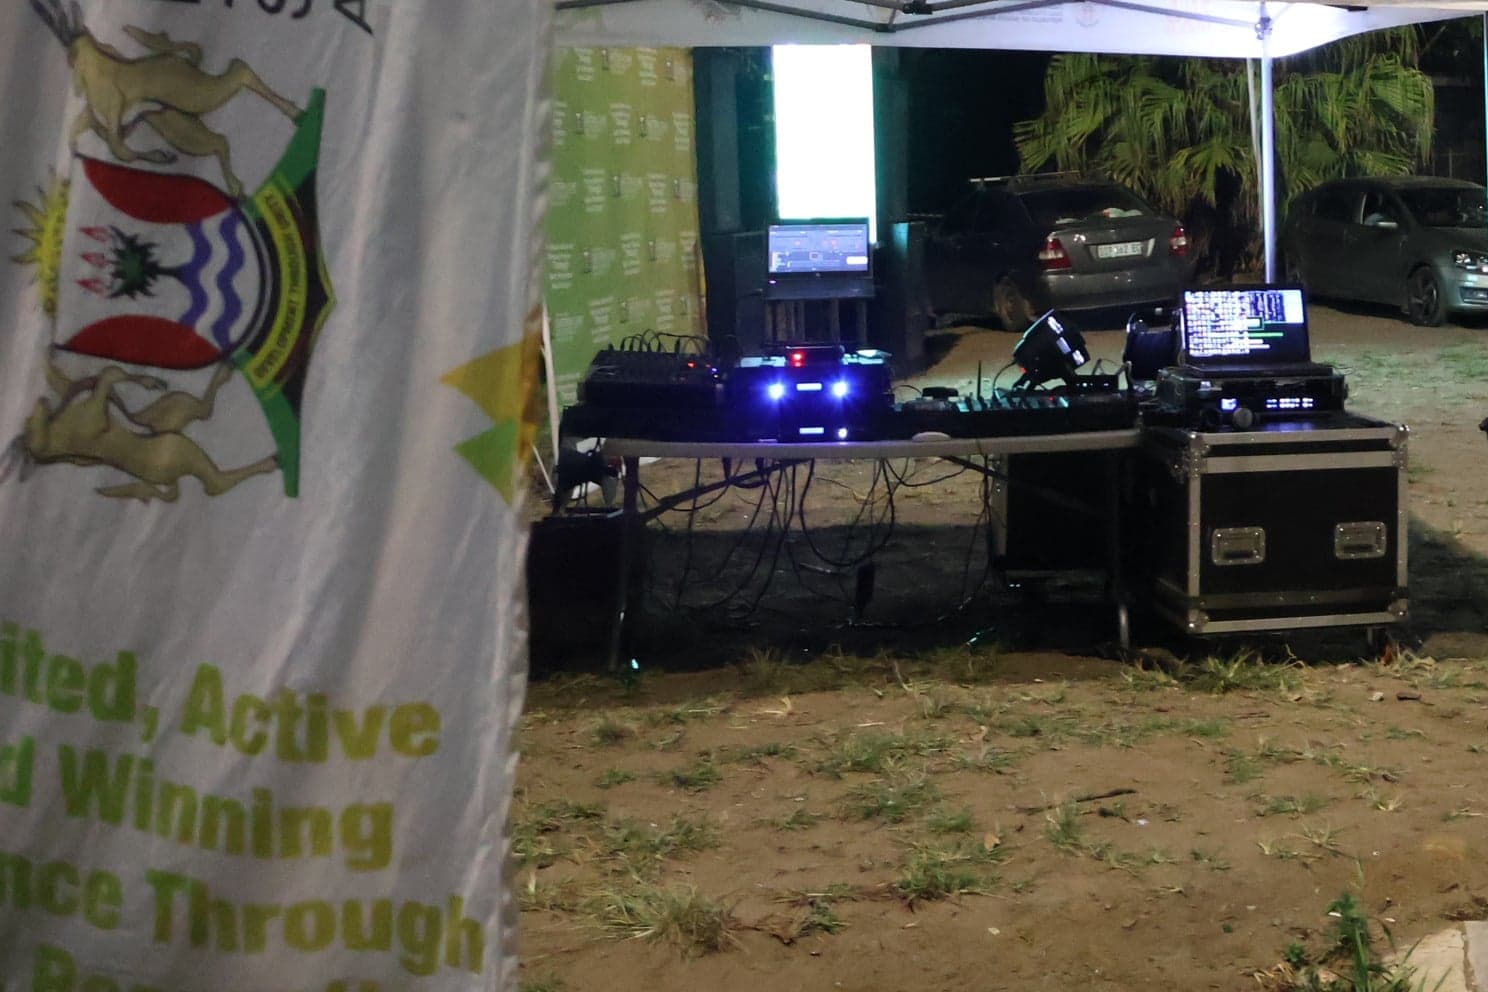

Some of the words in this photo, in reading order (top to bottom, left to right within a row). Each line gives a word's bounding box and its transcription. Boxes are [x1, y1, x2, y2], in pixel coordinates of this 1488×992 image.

[179, 663, 442, 765] Active
[58, 744, 394, 873] Winning
[145, 868, 486, 977] Through
